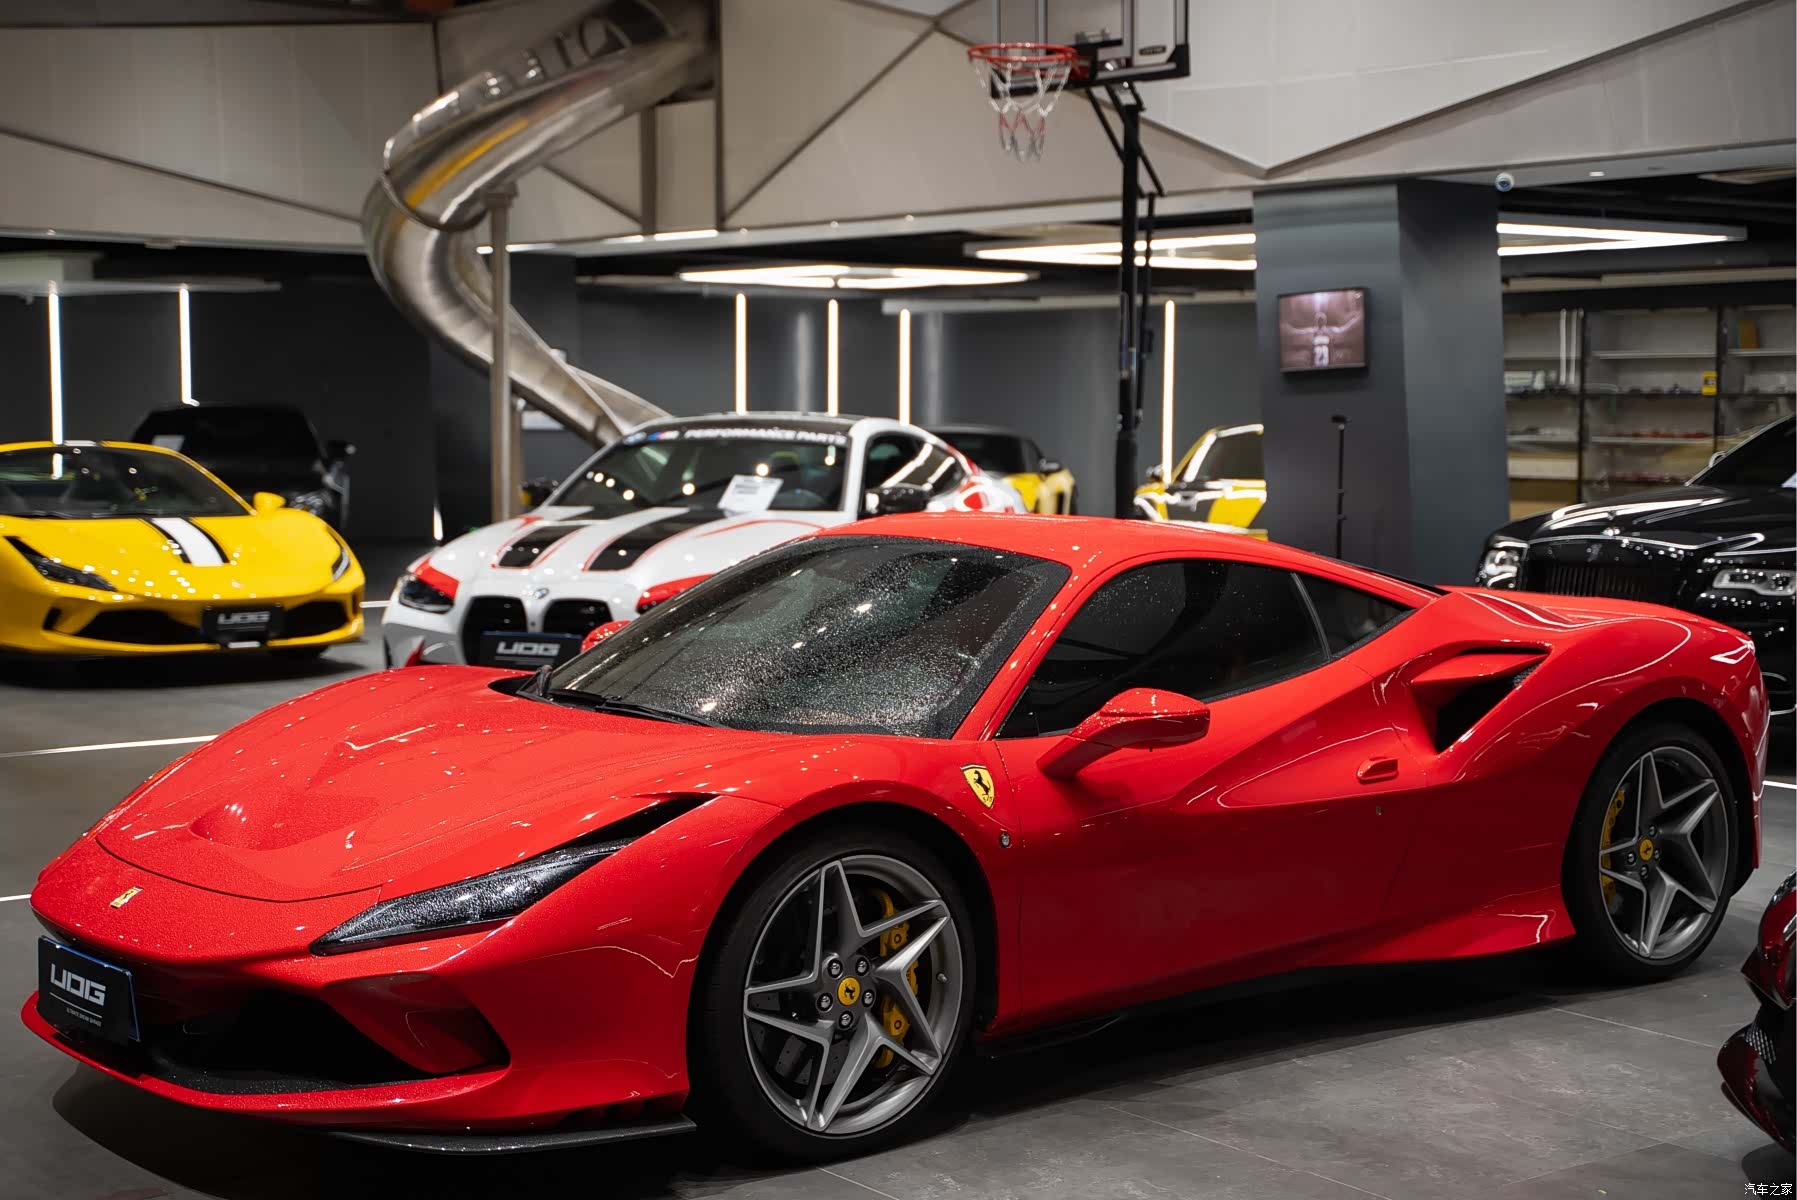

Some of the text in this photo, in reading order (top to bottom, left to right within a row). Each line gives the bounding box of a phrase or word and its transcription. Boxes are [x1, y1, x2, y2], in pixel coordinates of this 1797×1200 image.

[684, 428, 796, 440] PERFORMANCE
[797, 431, 847, 445] PARTS
[50, 963, 106, 1006] UDG
